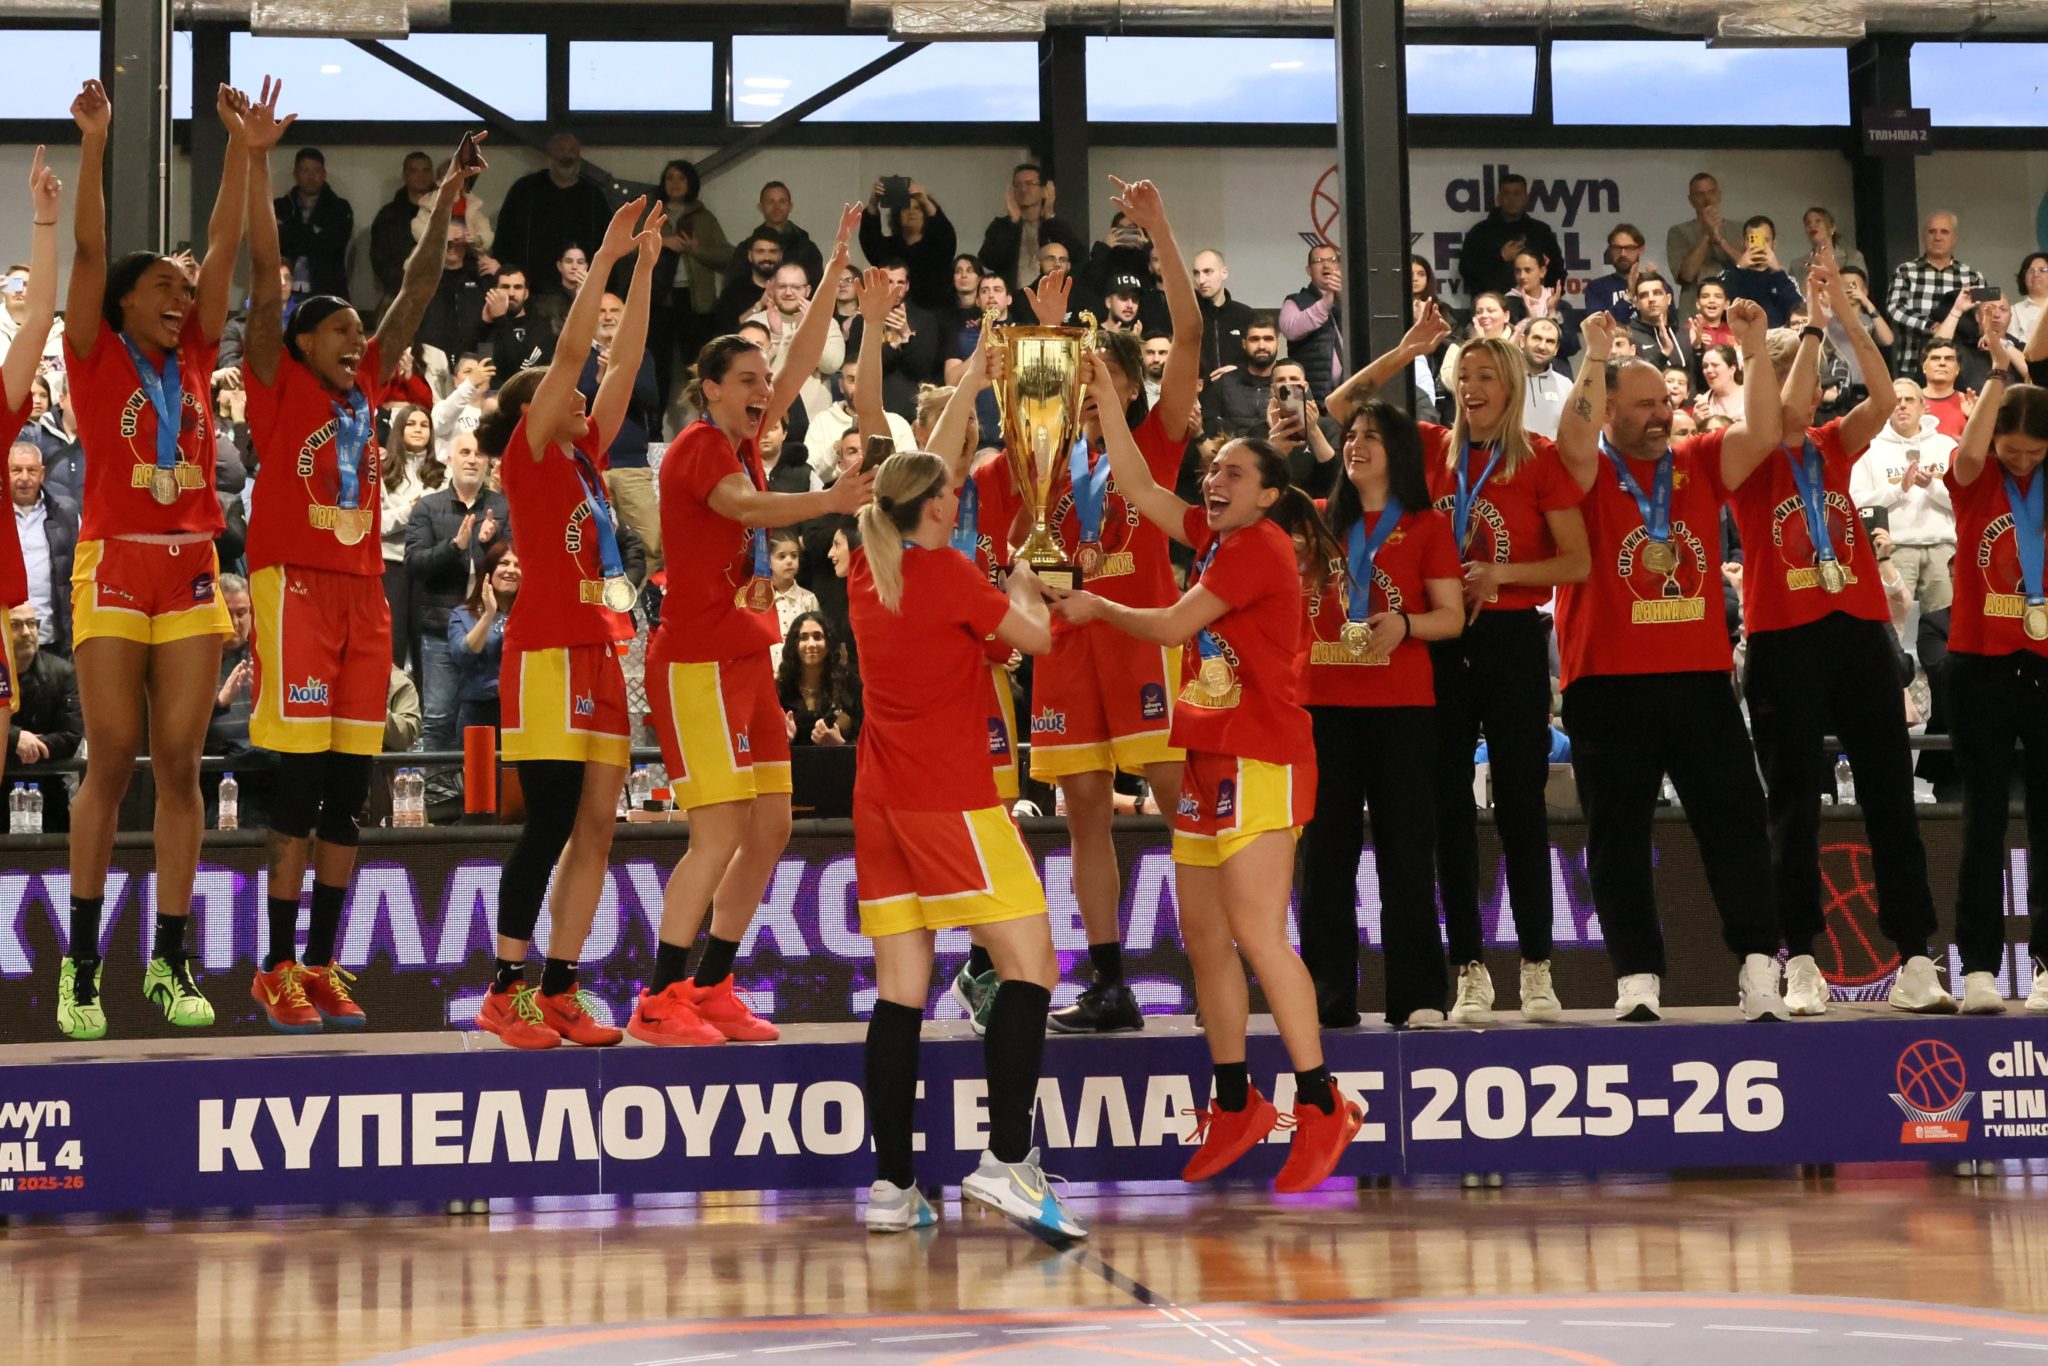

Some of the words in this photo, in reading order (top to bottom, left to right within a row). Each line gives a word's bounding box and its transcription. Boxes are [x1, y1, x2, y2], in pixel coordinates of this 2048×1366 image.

[1868, 130, 1918, 140] ΤΜΗΜΑ
[1919, 130, 1927, 140] 2
[1445, 164, 1620, 227] allwyn
[121, 408, 136, 437] CUP
[299, 447, 313, 476] CUP
[306, 418, 340, 450] WINNE
[566, 524, 581, 552] CUP
[1477, 500, 1510, 563] 2025-2026
[1623, 526, 1650, 551] WINN
[1979, 541, 1992, 567] CUP
[1986, 514, 2015, 543] WINN
[1619, 549, 1633, 576] CUP
[289, 684, 328, 705] λουξ
[199, 1080, 925, 1172] ΚΥΠΕΛΛΟΥΧΟ
[1410, 1060, 1784, 1141] 2025-26
[55, 1140, 83, 1170] 4
[18, 1176, 84, 1191] 2025-26
